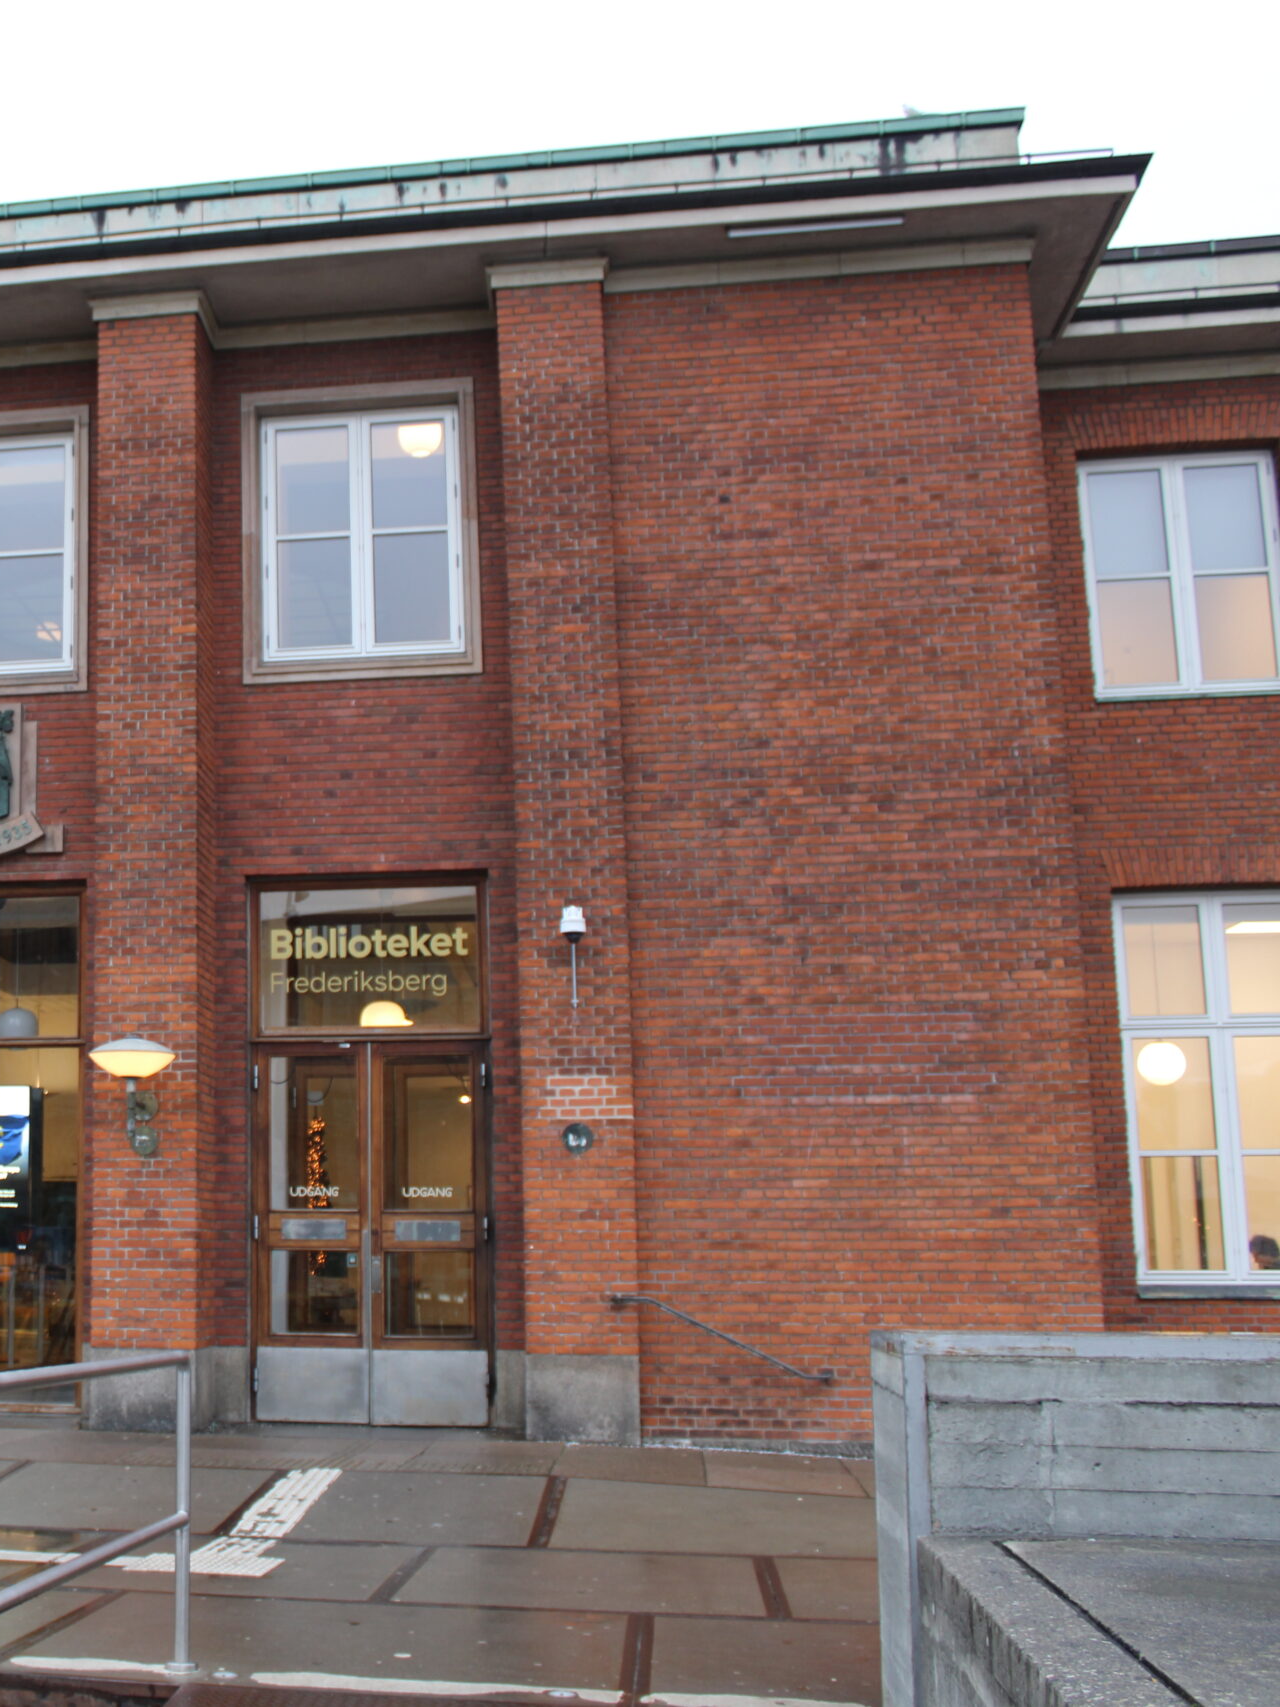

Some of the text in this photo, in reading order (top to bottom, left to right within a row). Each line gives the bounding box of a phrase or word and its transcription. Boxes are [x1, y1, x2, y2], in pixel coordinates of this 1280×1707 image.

[270, 925, 469, 960] Biblioteket
[270, 970, 448, 997] Frederiksberg
[289, 1185, 340, 1198] UDGANG
[402, 1186, 453, 1198] UDGANG
